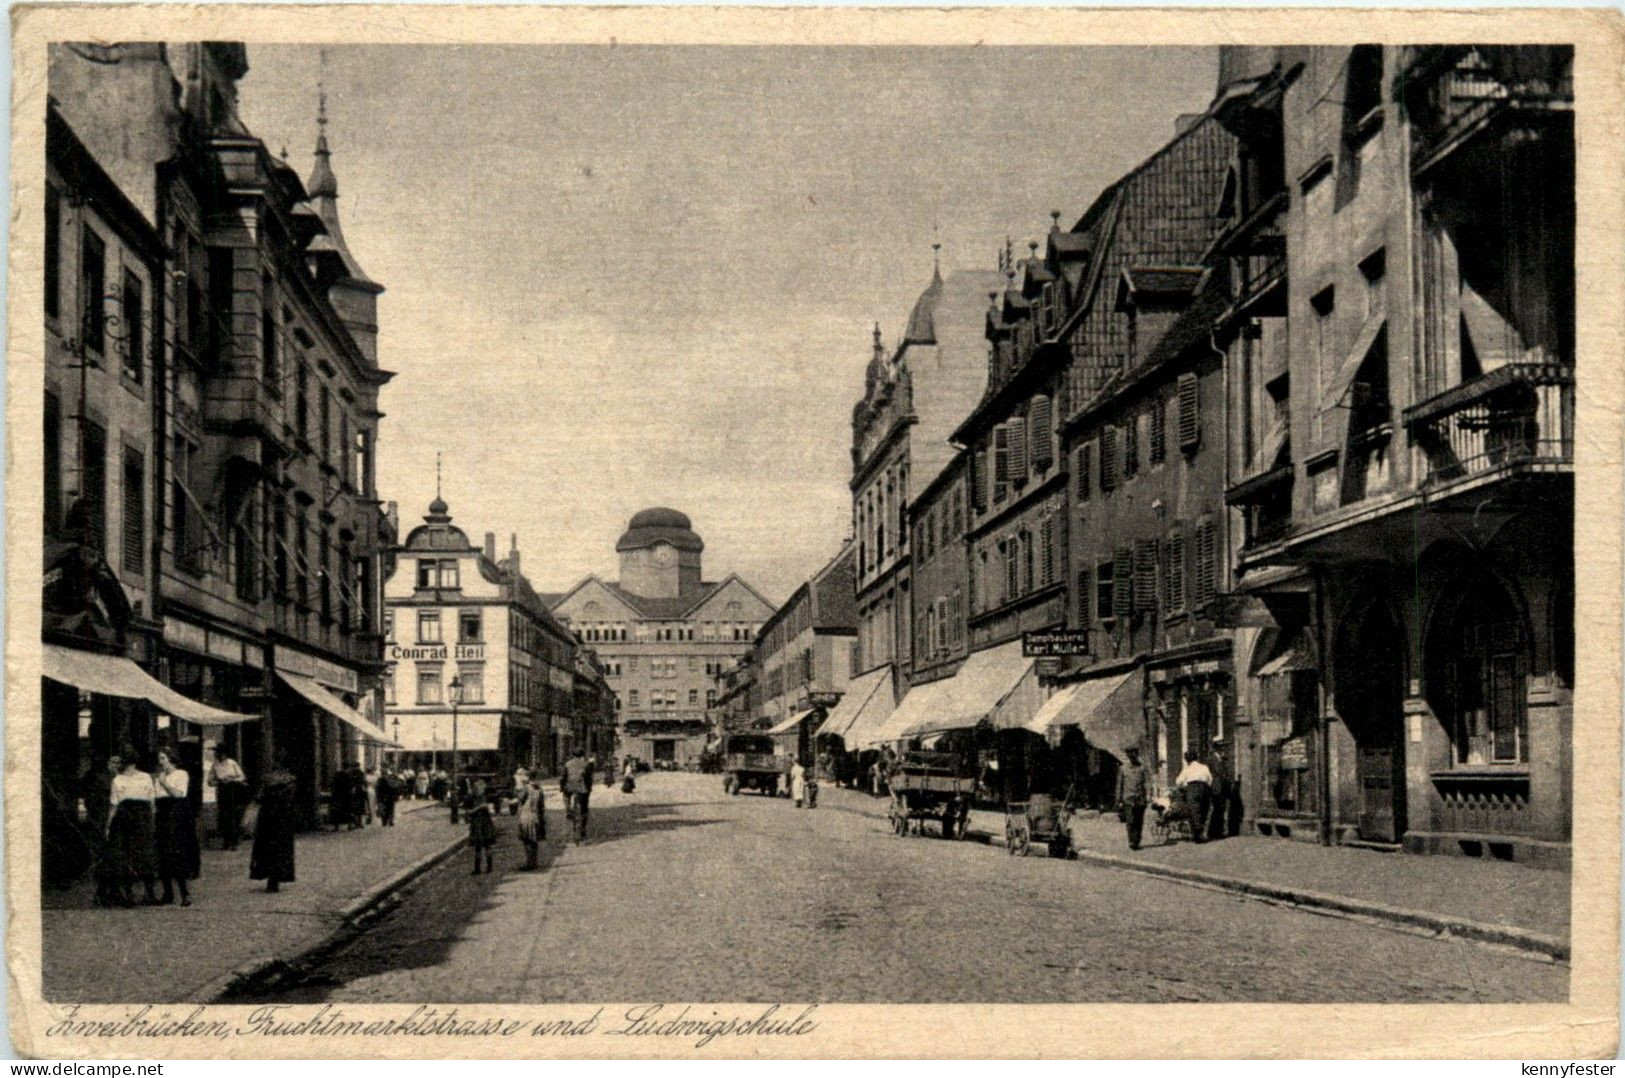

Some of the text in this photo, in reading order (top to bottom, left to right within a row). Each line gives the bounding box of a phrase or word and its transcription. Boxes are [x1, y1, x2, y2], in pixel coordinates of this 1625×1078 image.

[391, 645, 484, 659] Conrad Heil
[1026, 643, 1049, 654] Karl
